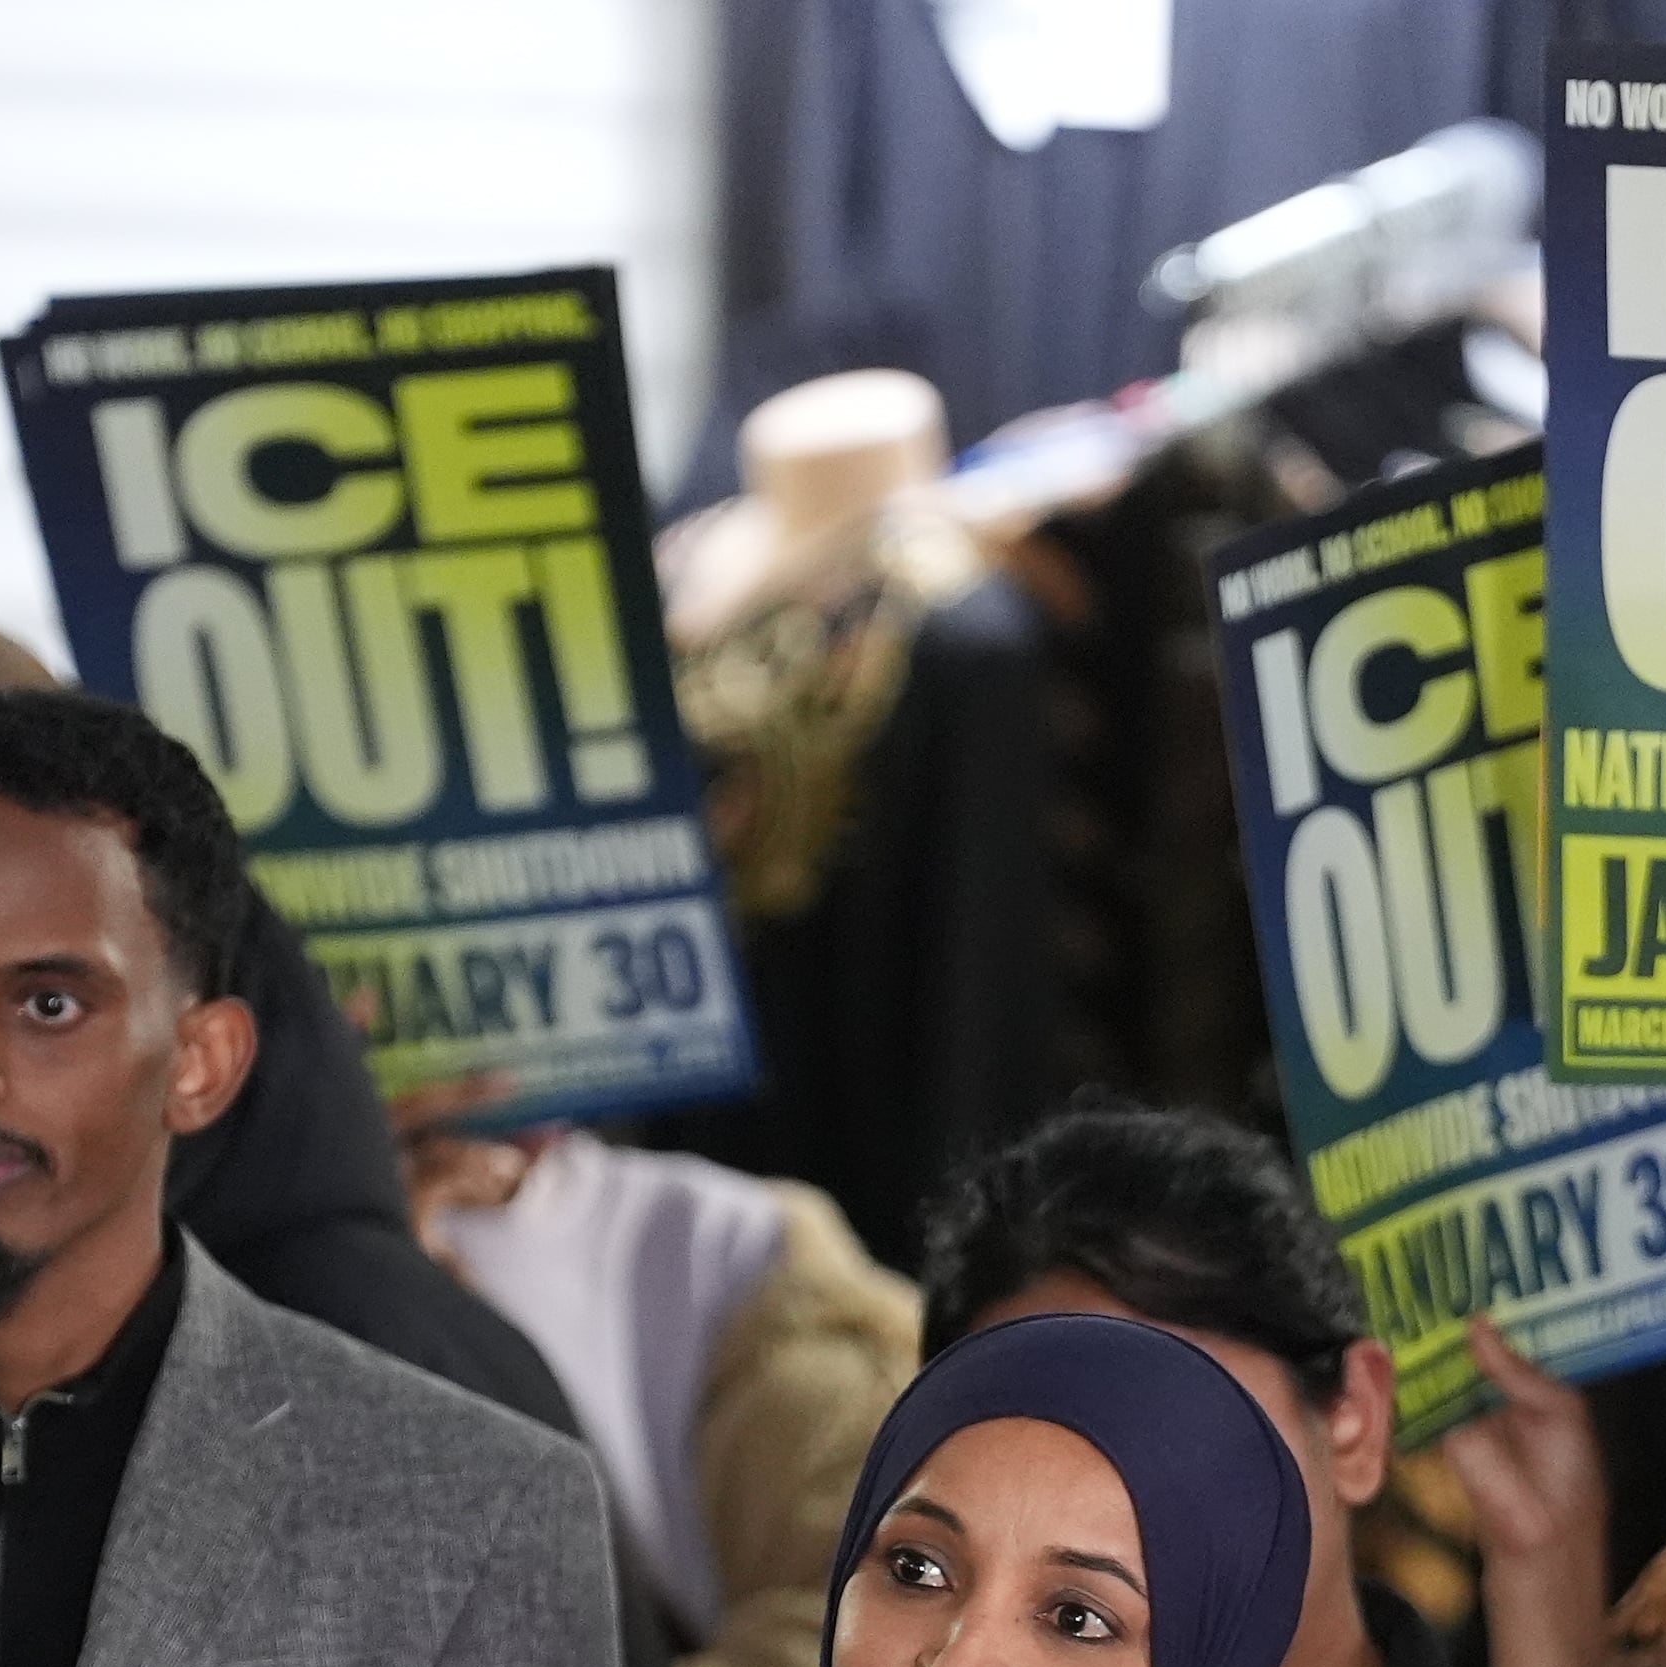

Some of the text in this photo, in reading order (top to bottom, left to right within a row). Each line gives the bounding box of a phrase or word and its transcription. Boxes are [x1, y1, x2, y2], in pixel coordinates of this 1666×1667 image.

[1566, 79, 1615, 128] NO
[90, 362, 596, 571] ICE
[136, 536, 653, 837] OUT!
[338, 922, 703, 1045] UARY 30
[1361, 1165, 1603, 1341] ANUARY
